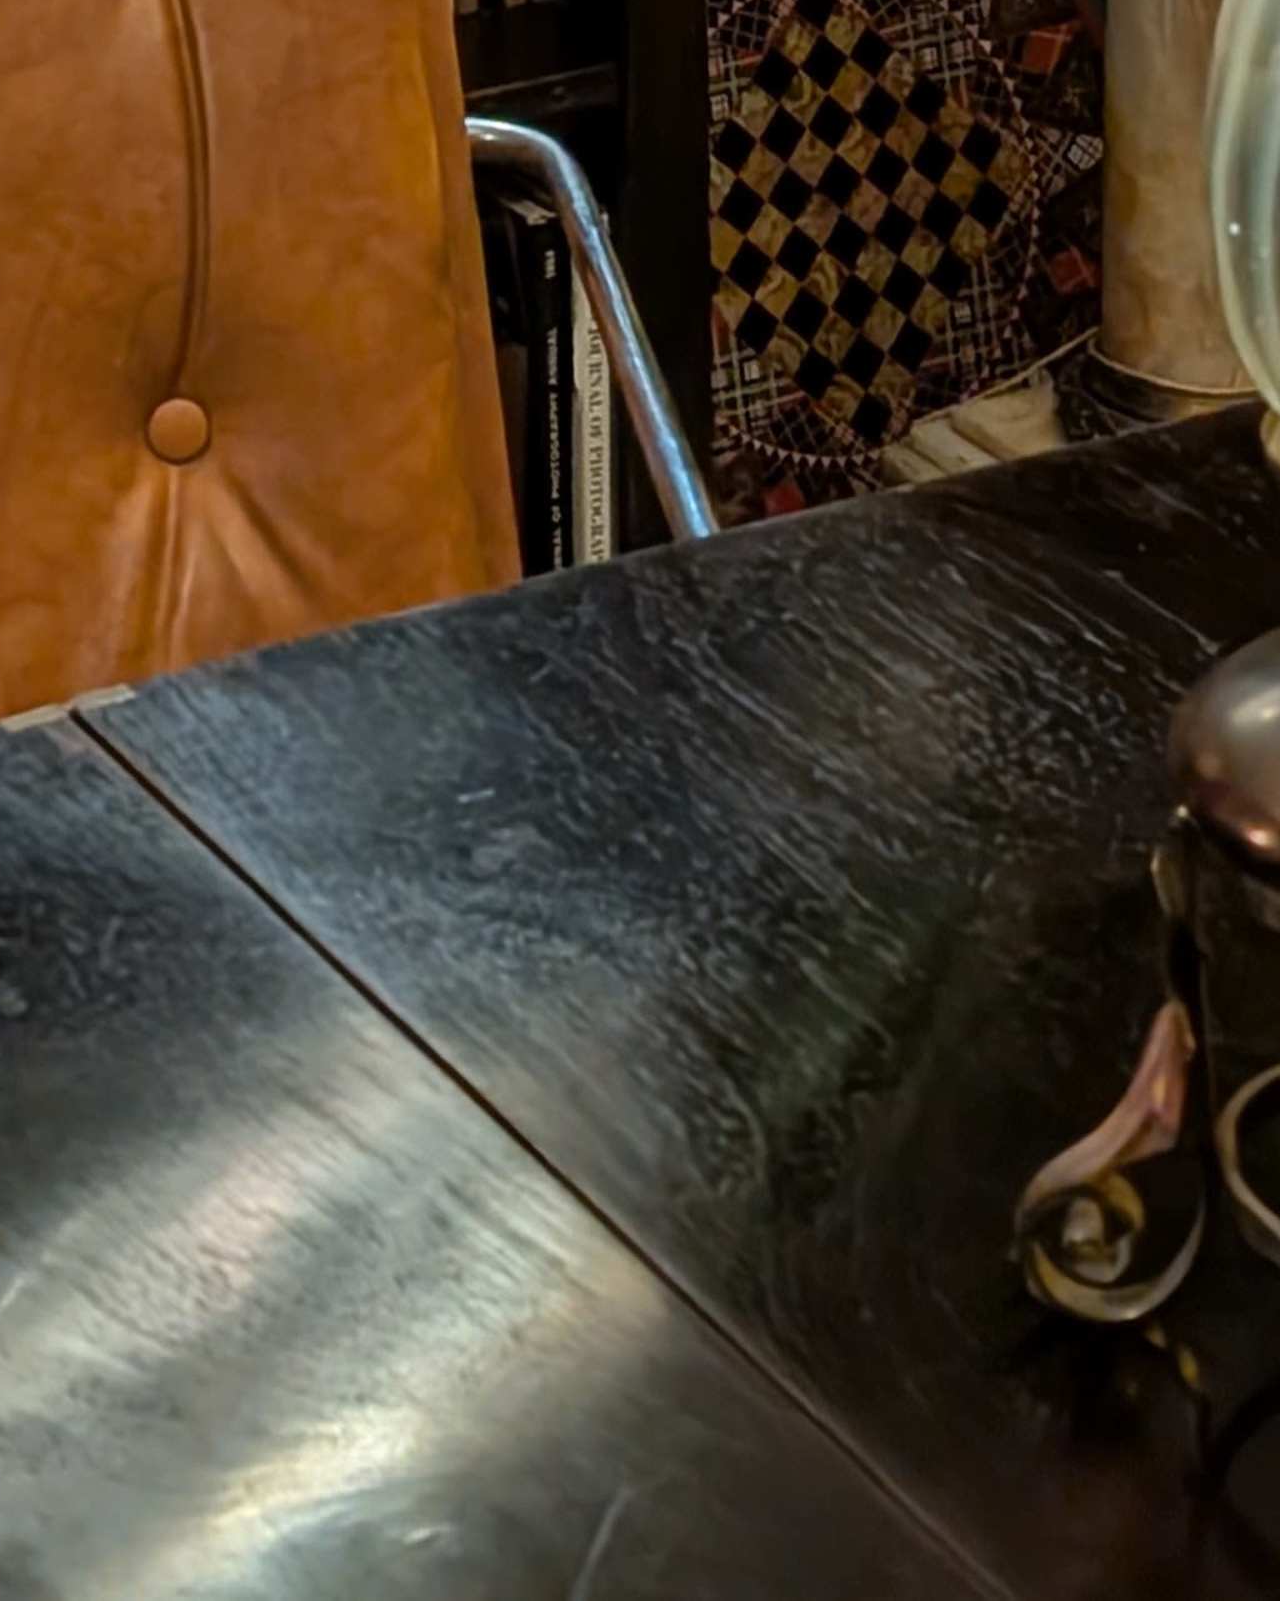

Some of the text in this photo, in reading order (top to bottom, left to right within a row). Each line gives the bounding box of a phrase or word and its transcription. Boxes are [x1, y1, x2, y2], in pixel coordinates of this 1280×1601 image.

[587, 328, 605, 563] JOURNAL OF PHOTOGRAP
